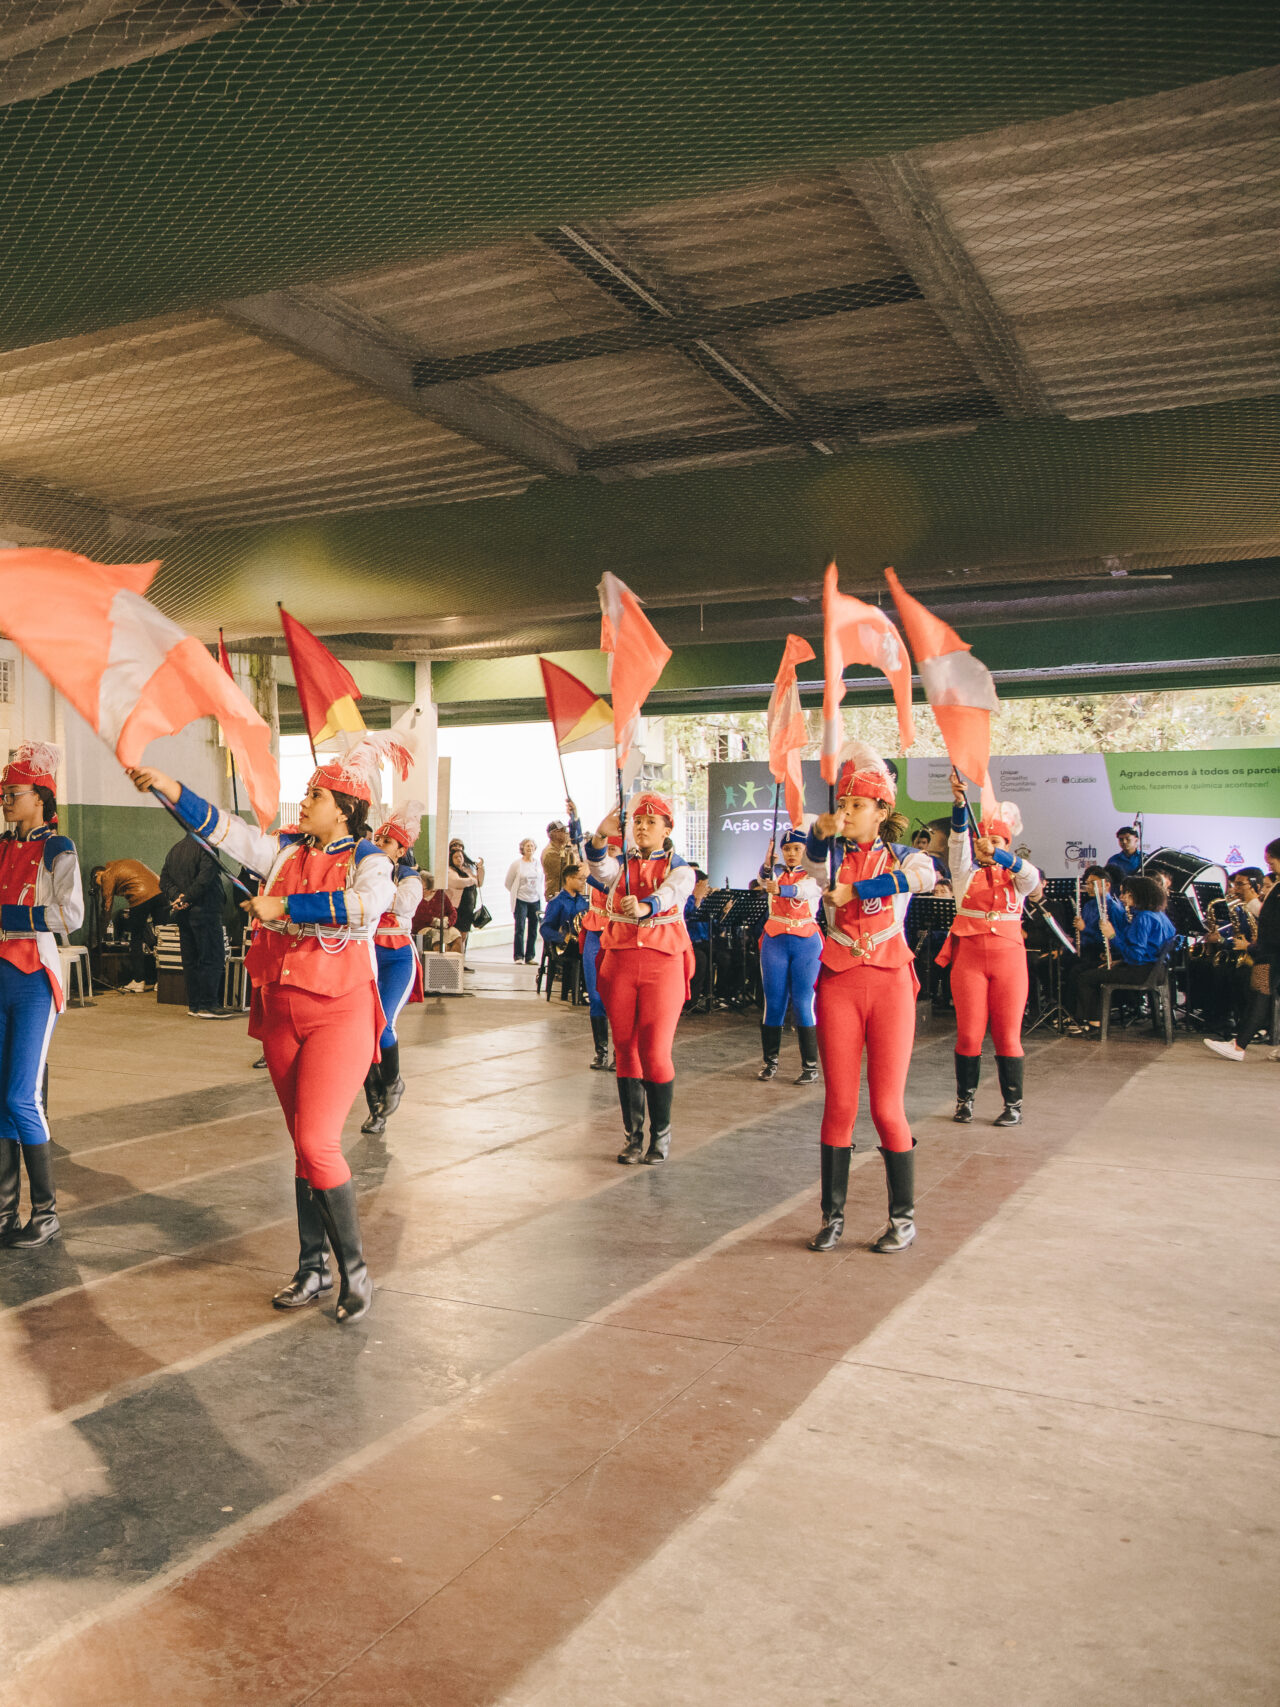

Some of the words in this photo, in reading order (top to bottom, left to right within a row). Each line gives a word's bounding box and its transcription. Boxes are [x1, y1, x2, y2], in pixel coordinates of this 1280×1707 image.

[1119, 769, 1189, 780] Agradecemos
[1200, 767, 1229, 777] todos
[1150, 782, 1182, 791] fazemos
[721, 818, 760, 834] Ação
[1064, 843, 1097, 860] Canto
